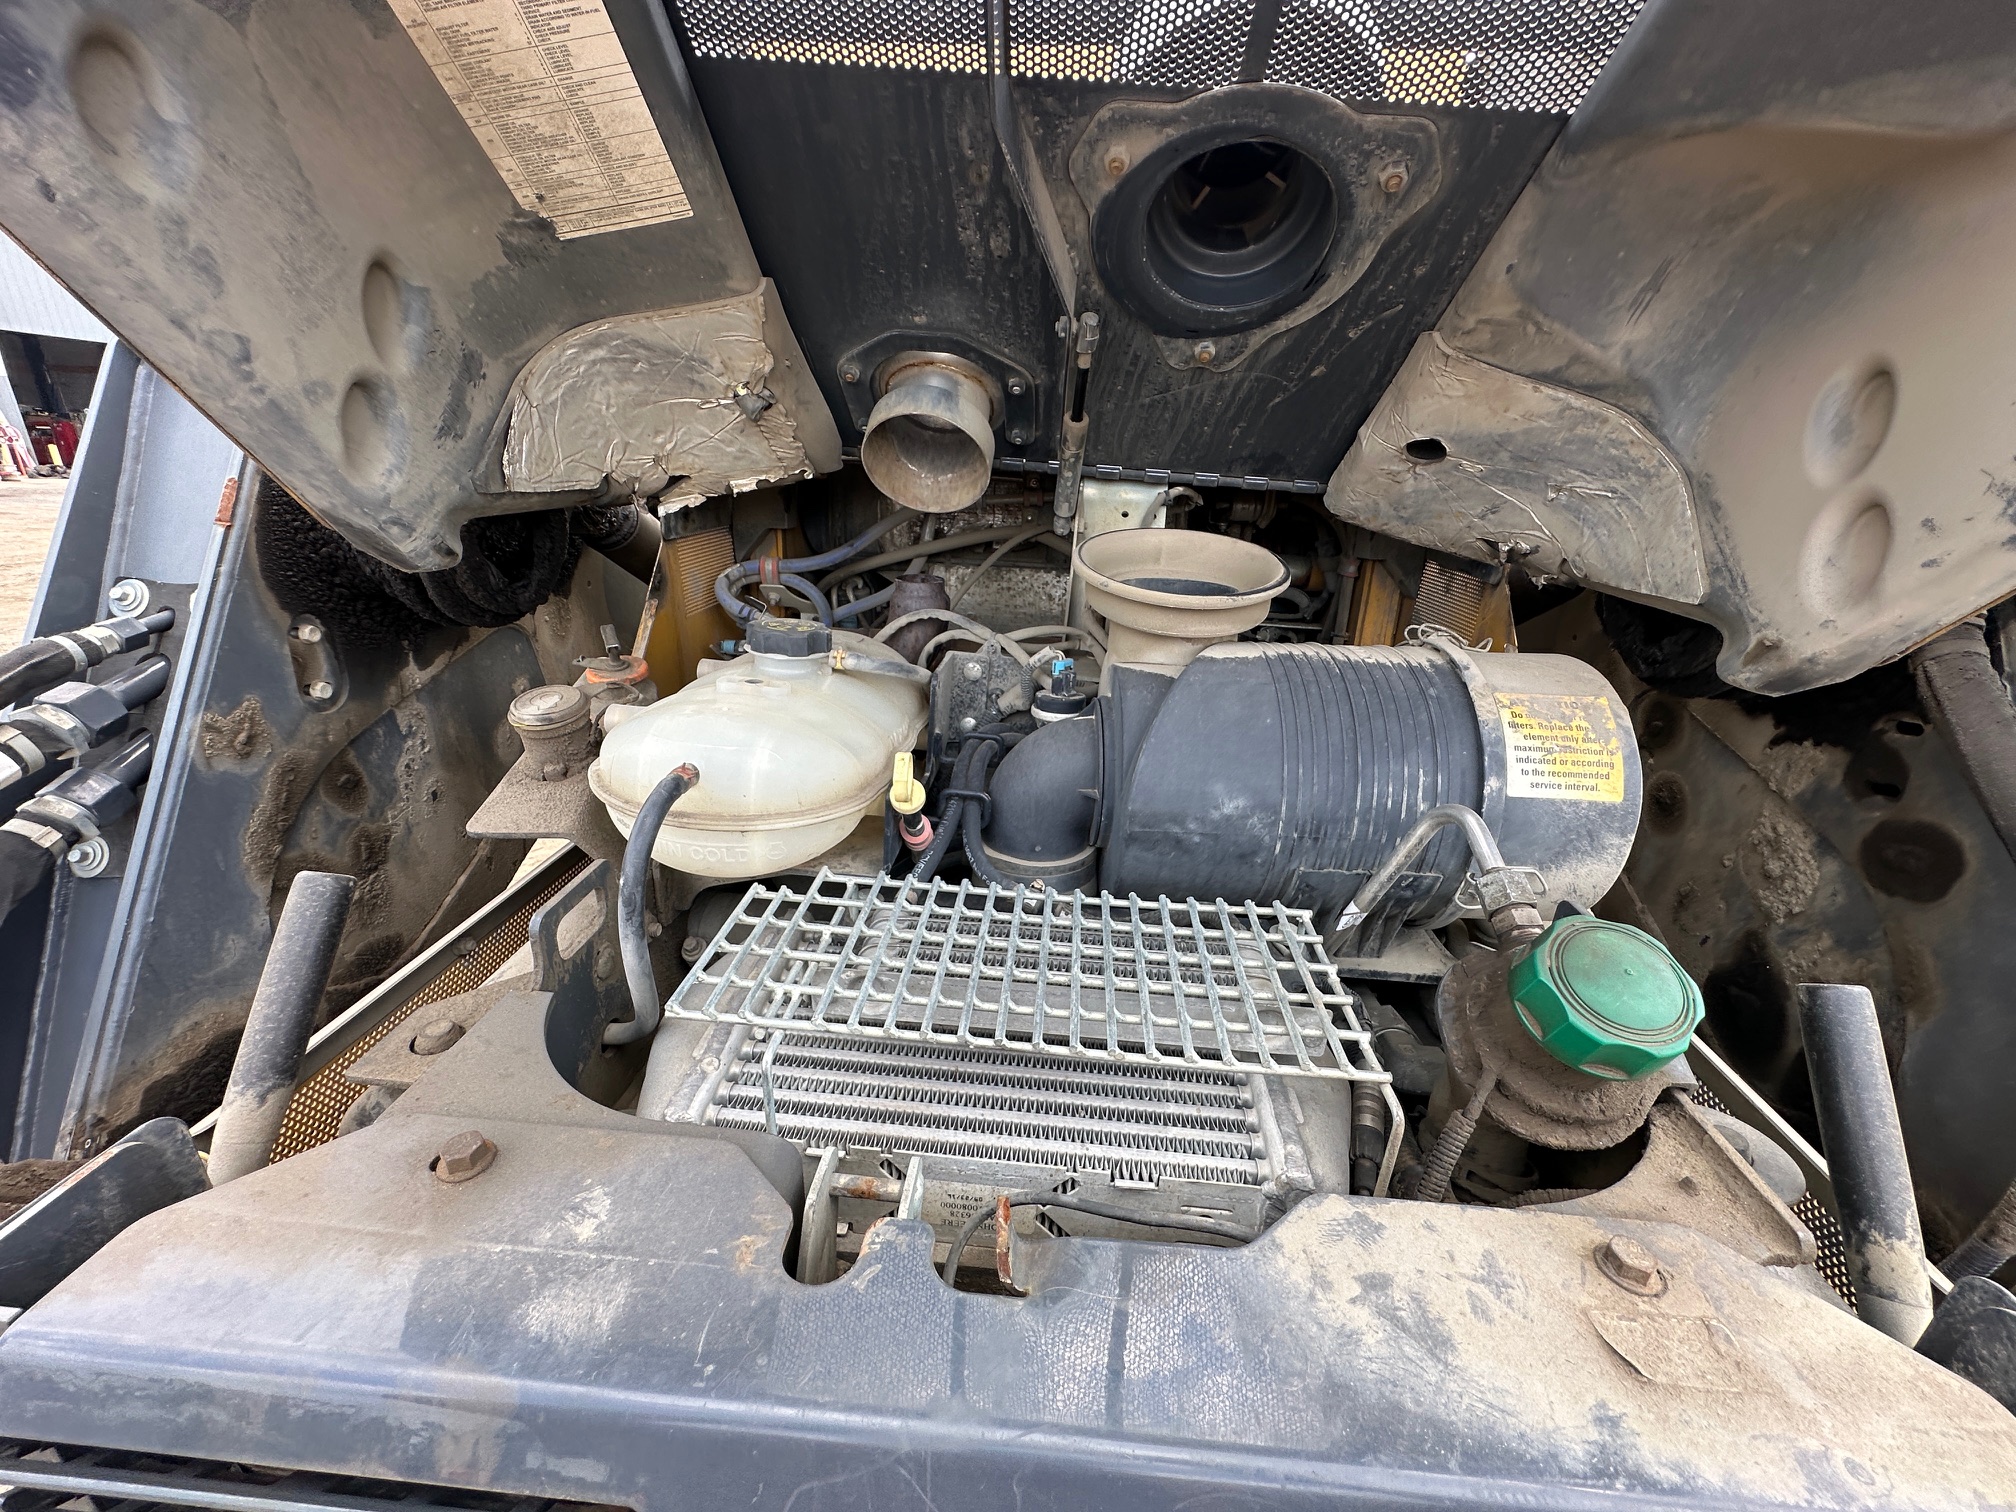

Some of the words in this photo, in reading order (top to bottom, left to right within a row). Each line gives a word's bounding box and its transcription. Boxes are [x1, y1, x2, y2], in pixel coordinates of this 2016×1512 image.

[1538, 722, 1573, 732] Replace
[1524, 733, 1558, 742] element
[1560, 736, 1578, 744] only
[1516, 756, 1556, 765] indicated
[1571, 760, 1614, 770] according
[1548, 770, 1610, 780] recommended
[1565, 782, 1600, 792] interval.
[690, 845, 752, 864] COLD
